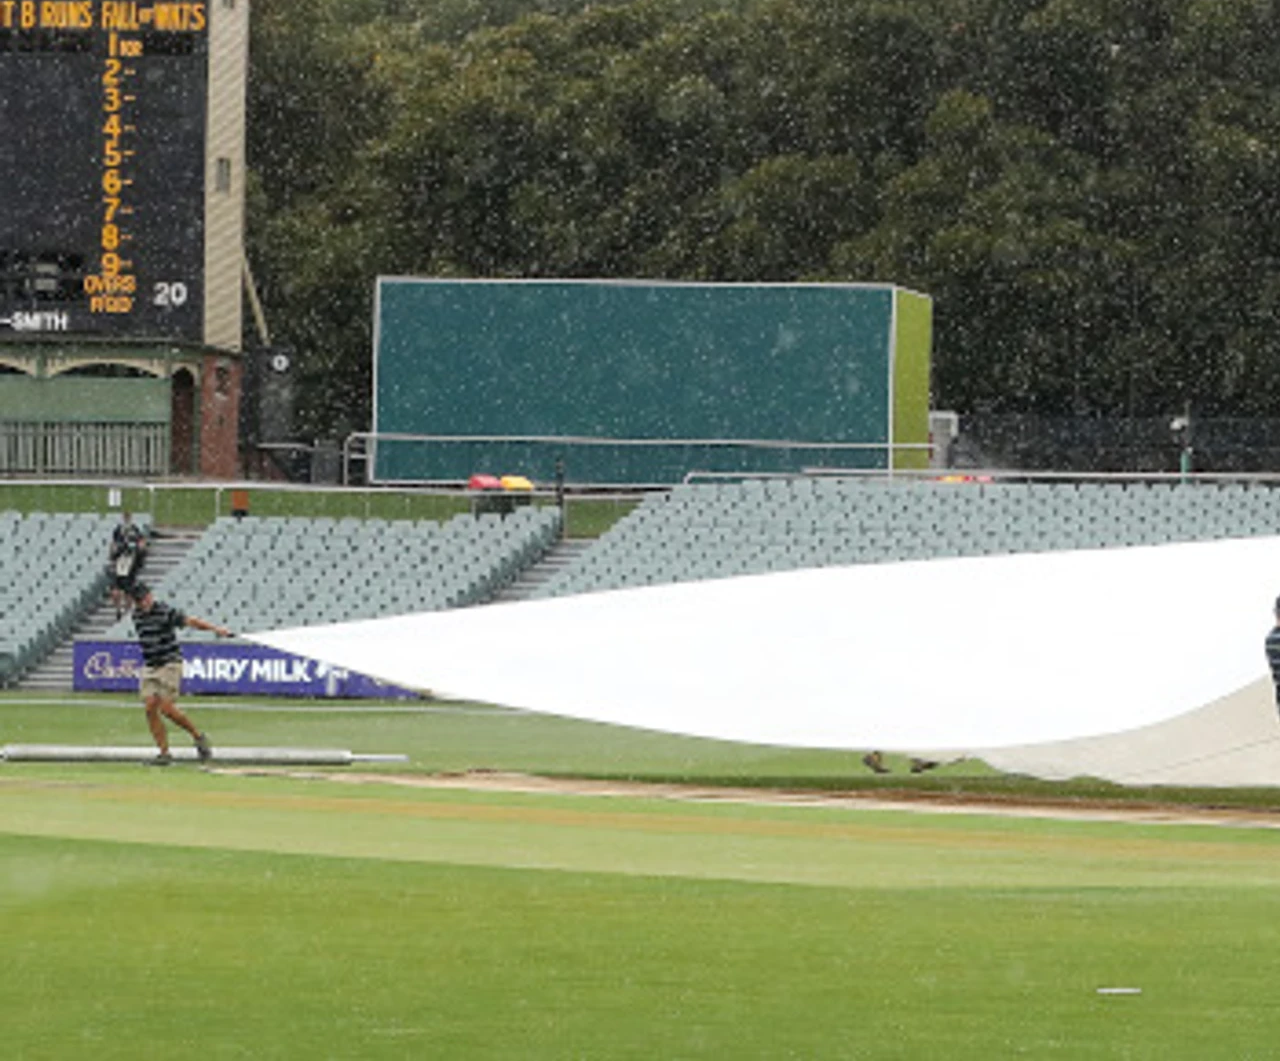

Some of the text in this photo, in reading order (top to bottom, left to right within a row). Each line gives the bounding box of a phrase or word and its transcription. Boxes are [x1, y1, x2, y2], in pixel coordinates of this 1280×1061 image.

[21, 0, 36, 29] B
[40, 0, 93, 29] RUNS
[101, 0, 140, 30] FALL
[153, 1, 206, 31] WKTS
[153, 281, 188, 306] 20
[251, 658, 312, 683] MILK
